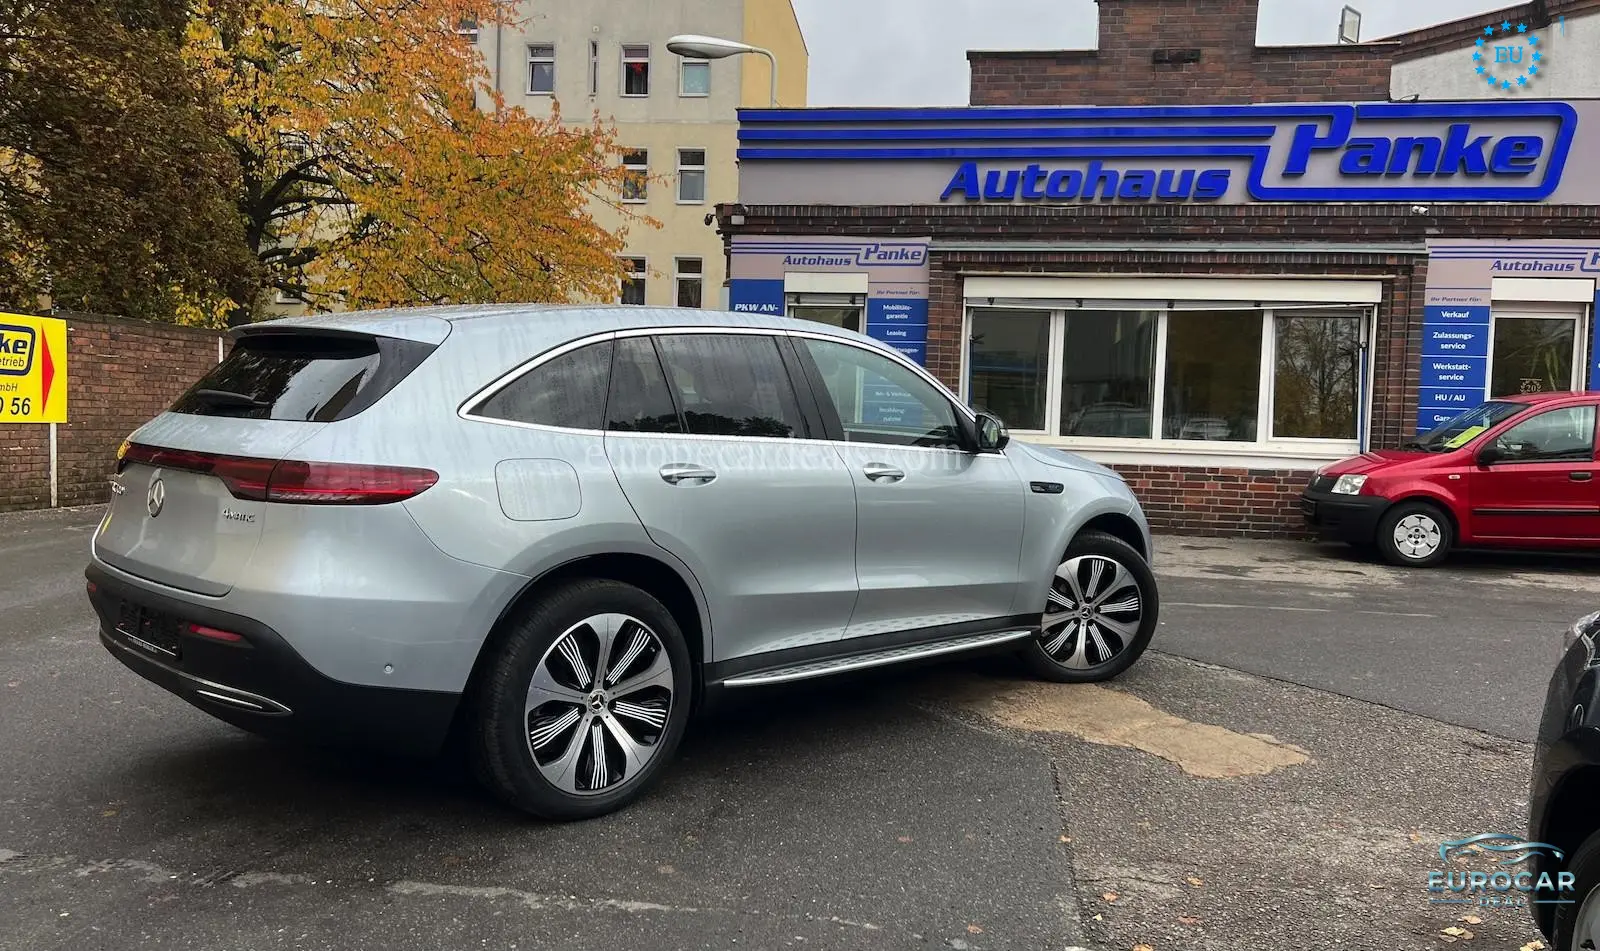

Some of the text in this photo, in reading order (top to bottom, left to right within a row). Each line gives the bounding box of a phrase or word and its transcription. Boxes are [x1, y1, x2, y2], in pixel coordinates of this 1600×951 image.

[940, 106, 1545, 201] Autohaus Panke
[782, 244, 922, 266] Autohaus Panke
[1490, 260, 1575, 272] Autohaus
[734, 303, 779, 312] PKW AN-
[1441, 310, 1470, 318] Verkauf
[1432, 331, 1475, 340] Zulassungs-
[1440, 342, 1466, 350] service
[1432, 363, 1471, 371] Werkstatt-
[1439, 373, 1464, 381] service
[10, 397, 31, 416] 56
